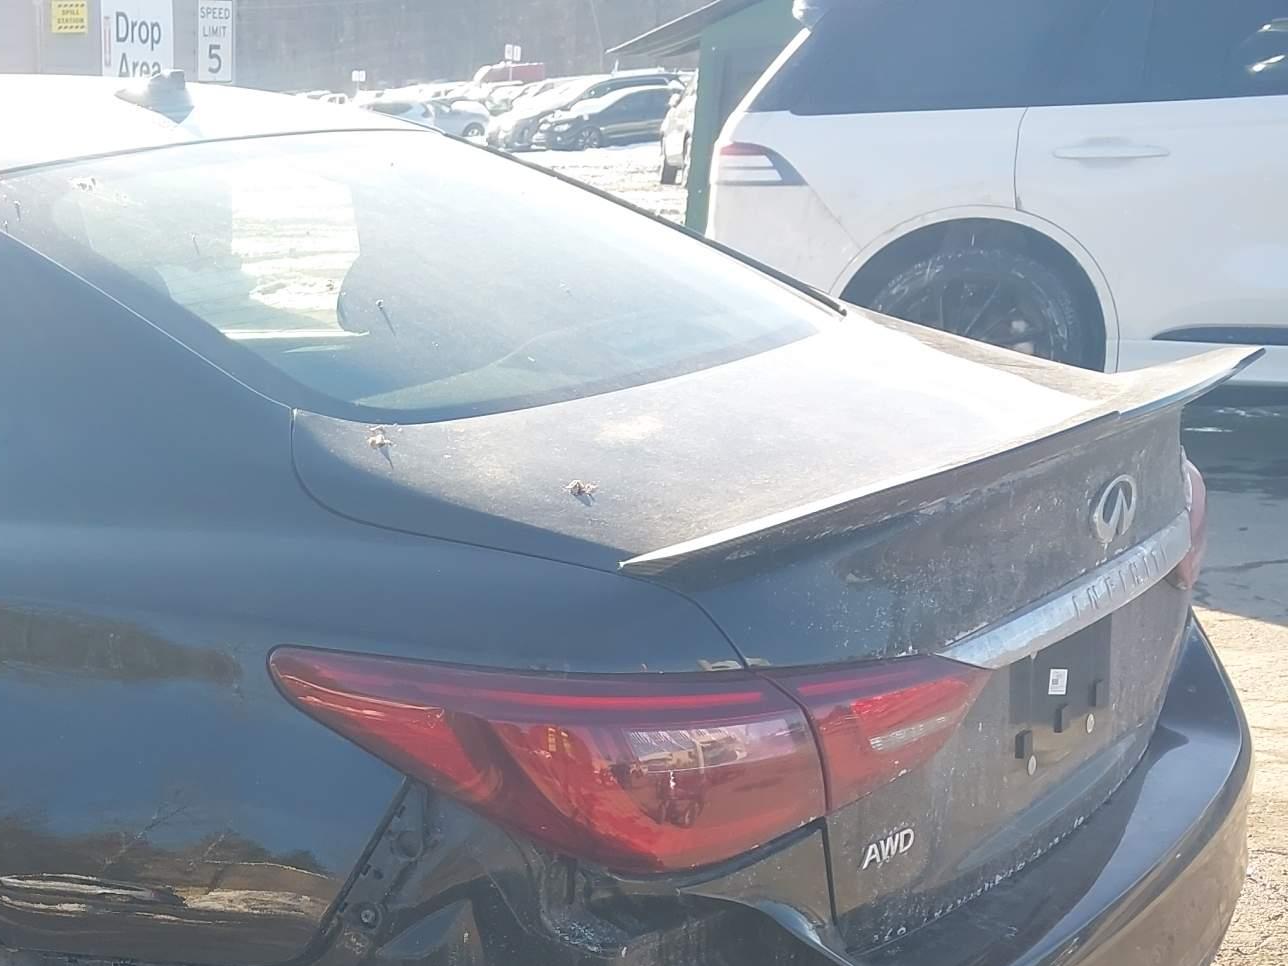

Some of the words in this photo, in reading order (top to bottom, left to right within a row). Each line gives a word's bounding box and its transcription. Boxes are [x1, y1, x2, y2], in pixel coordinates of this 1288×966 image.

[200, 7, 231, 20] SPEED
[115, 11, 161, 51] Drop
[202, 26, 227, 38] LIMIT
[208, 44, 222, 74] 5
[862, 828, 915, 870] AWD
